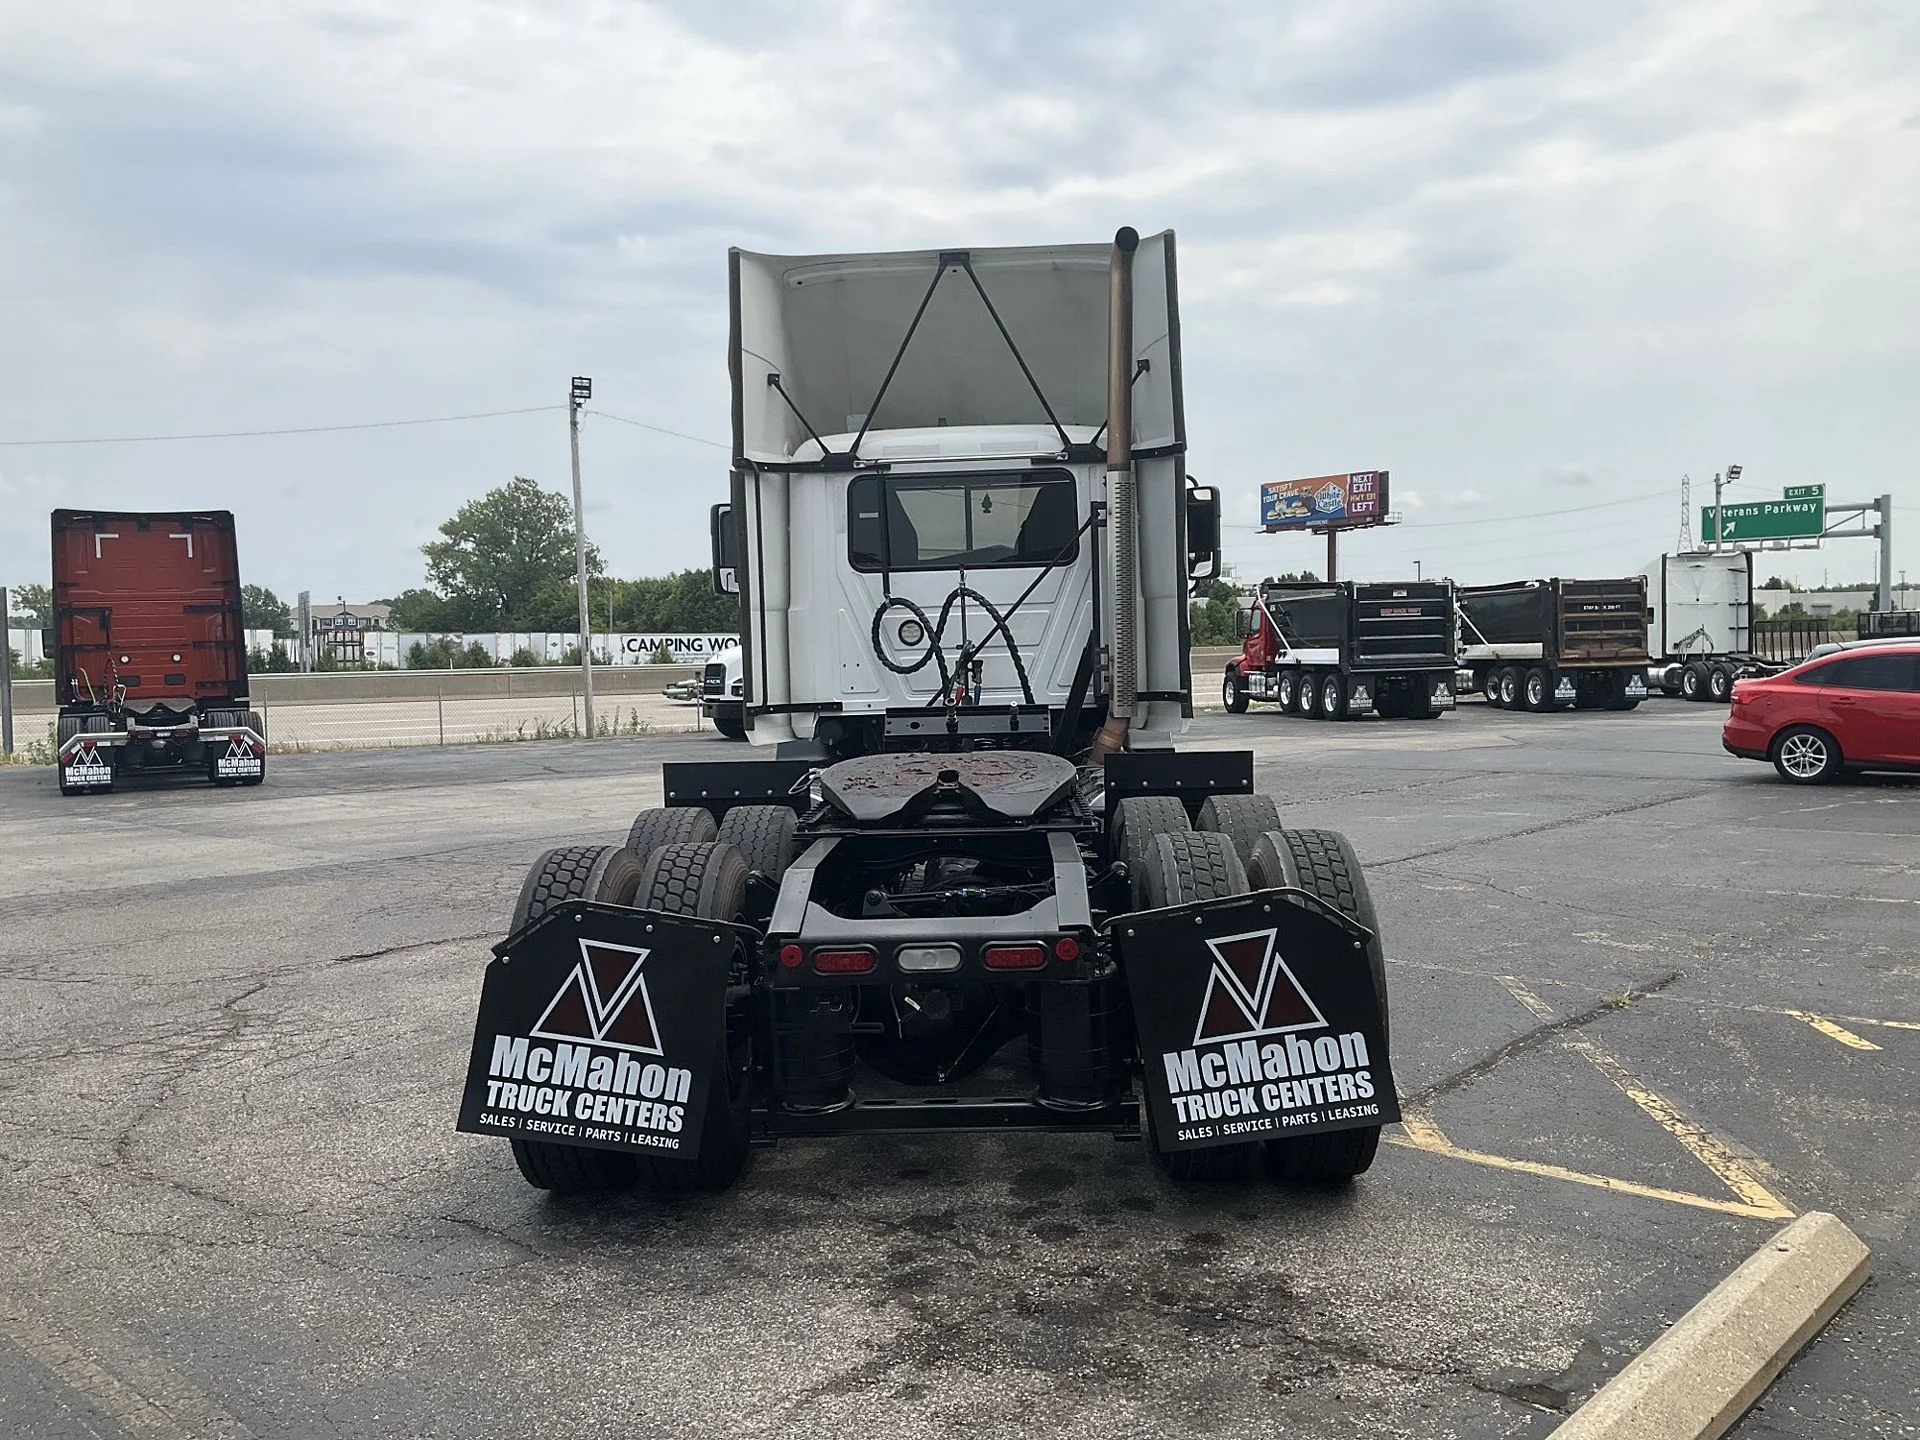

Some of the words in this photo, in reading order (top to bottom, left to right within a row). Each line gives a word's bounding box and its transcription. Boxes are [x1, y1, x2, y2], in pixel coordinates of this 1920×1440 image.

[1353, 474, 1373, 483] NEXT
[1268, 483, 1292, 494] SATISFY
[1353, 483, 1372, 492] EXIT
[1788, 488, 1805, 496] EXIT
[1812, 486, 1819, 495] 5
[1263, 493, 1278, 503] YOUR
[1279, 488, 1299, 499] CRAVE
[1319, 491, 1342, 501] White
[1350, 494, 1365, 502] HWY
[1318, 499, 1342, 508] Castle
[1352, 502, 1374, 512] LEFT
[1708, 507, 1759, 519] Vterans
[1764, 502, 1817, 514] Parkway
[627, 638, 703, 653] CAMPING
[217, 758, 261, 768] McMahon
[65, 766, 111, 776] McMahon
[1163, 1031, 1370, 1094] McMahon
[489, 1034, 691, 1103] McMahon
[1171, 1087, 1259, 1124] TRUCK
[1262, 1071, 1375, 1112] CENTERS
[487, 1080, 572, 1117] TRUCK
[575, 1094, 684, 1133] CENTERS
[1178, 1126, 1213, 1141] SALES
[1223, 1118, 1272, 1136] SERVICE
[1282, 1112, 1318, 1127] PARTS
[1328, 1103, 1379, 1121] LEASING
[480, 1113, 515, 1128] SALES
[526, 1119, 575, 1136] SERVICE
[585, 1127, 621, 1142] PARTS
[631, 1132, 680, 1149] LEASING
